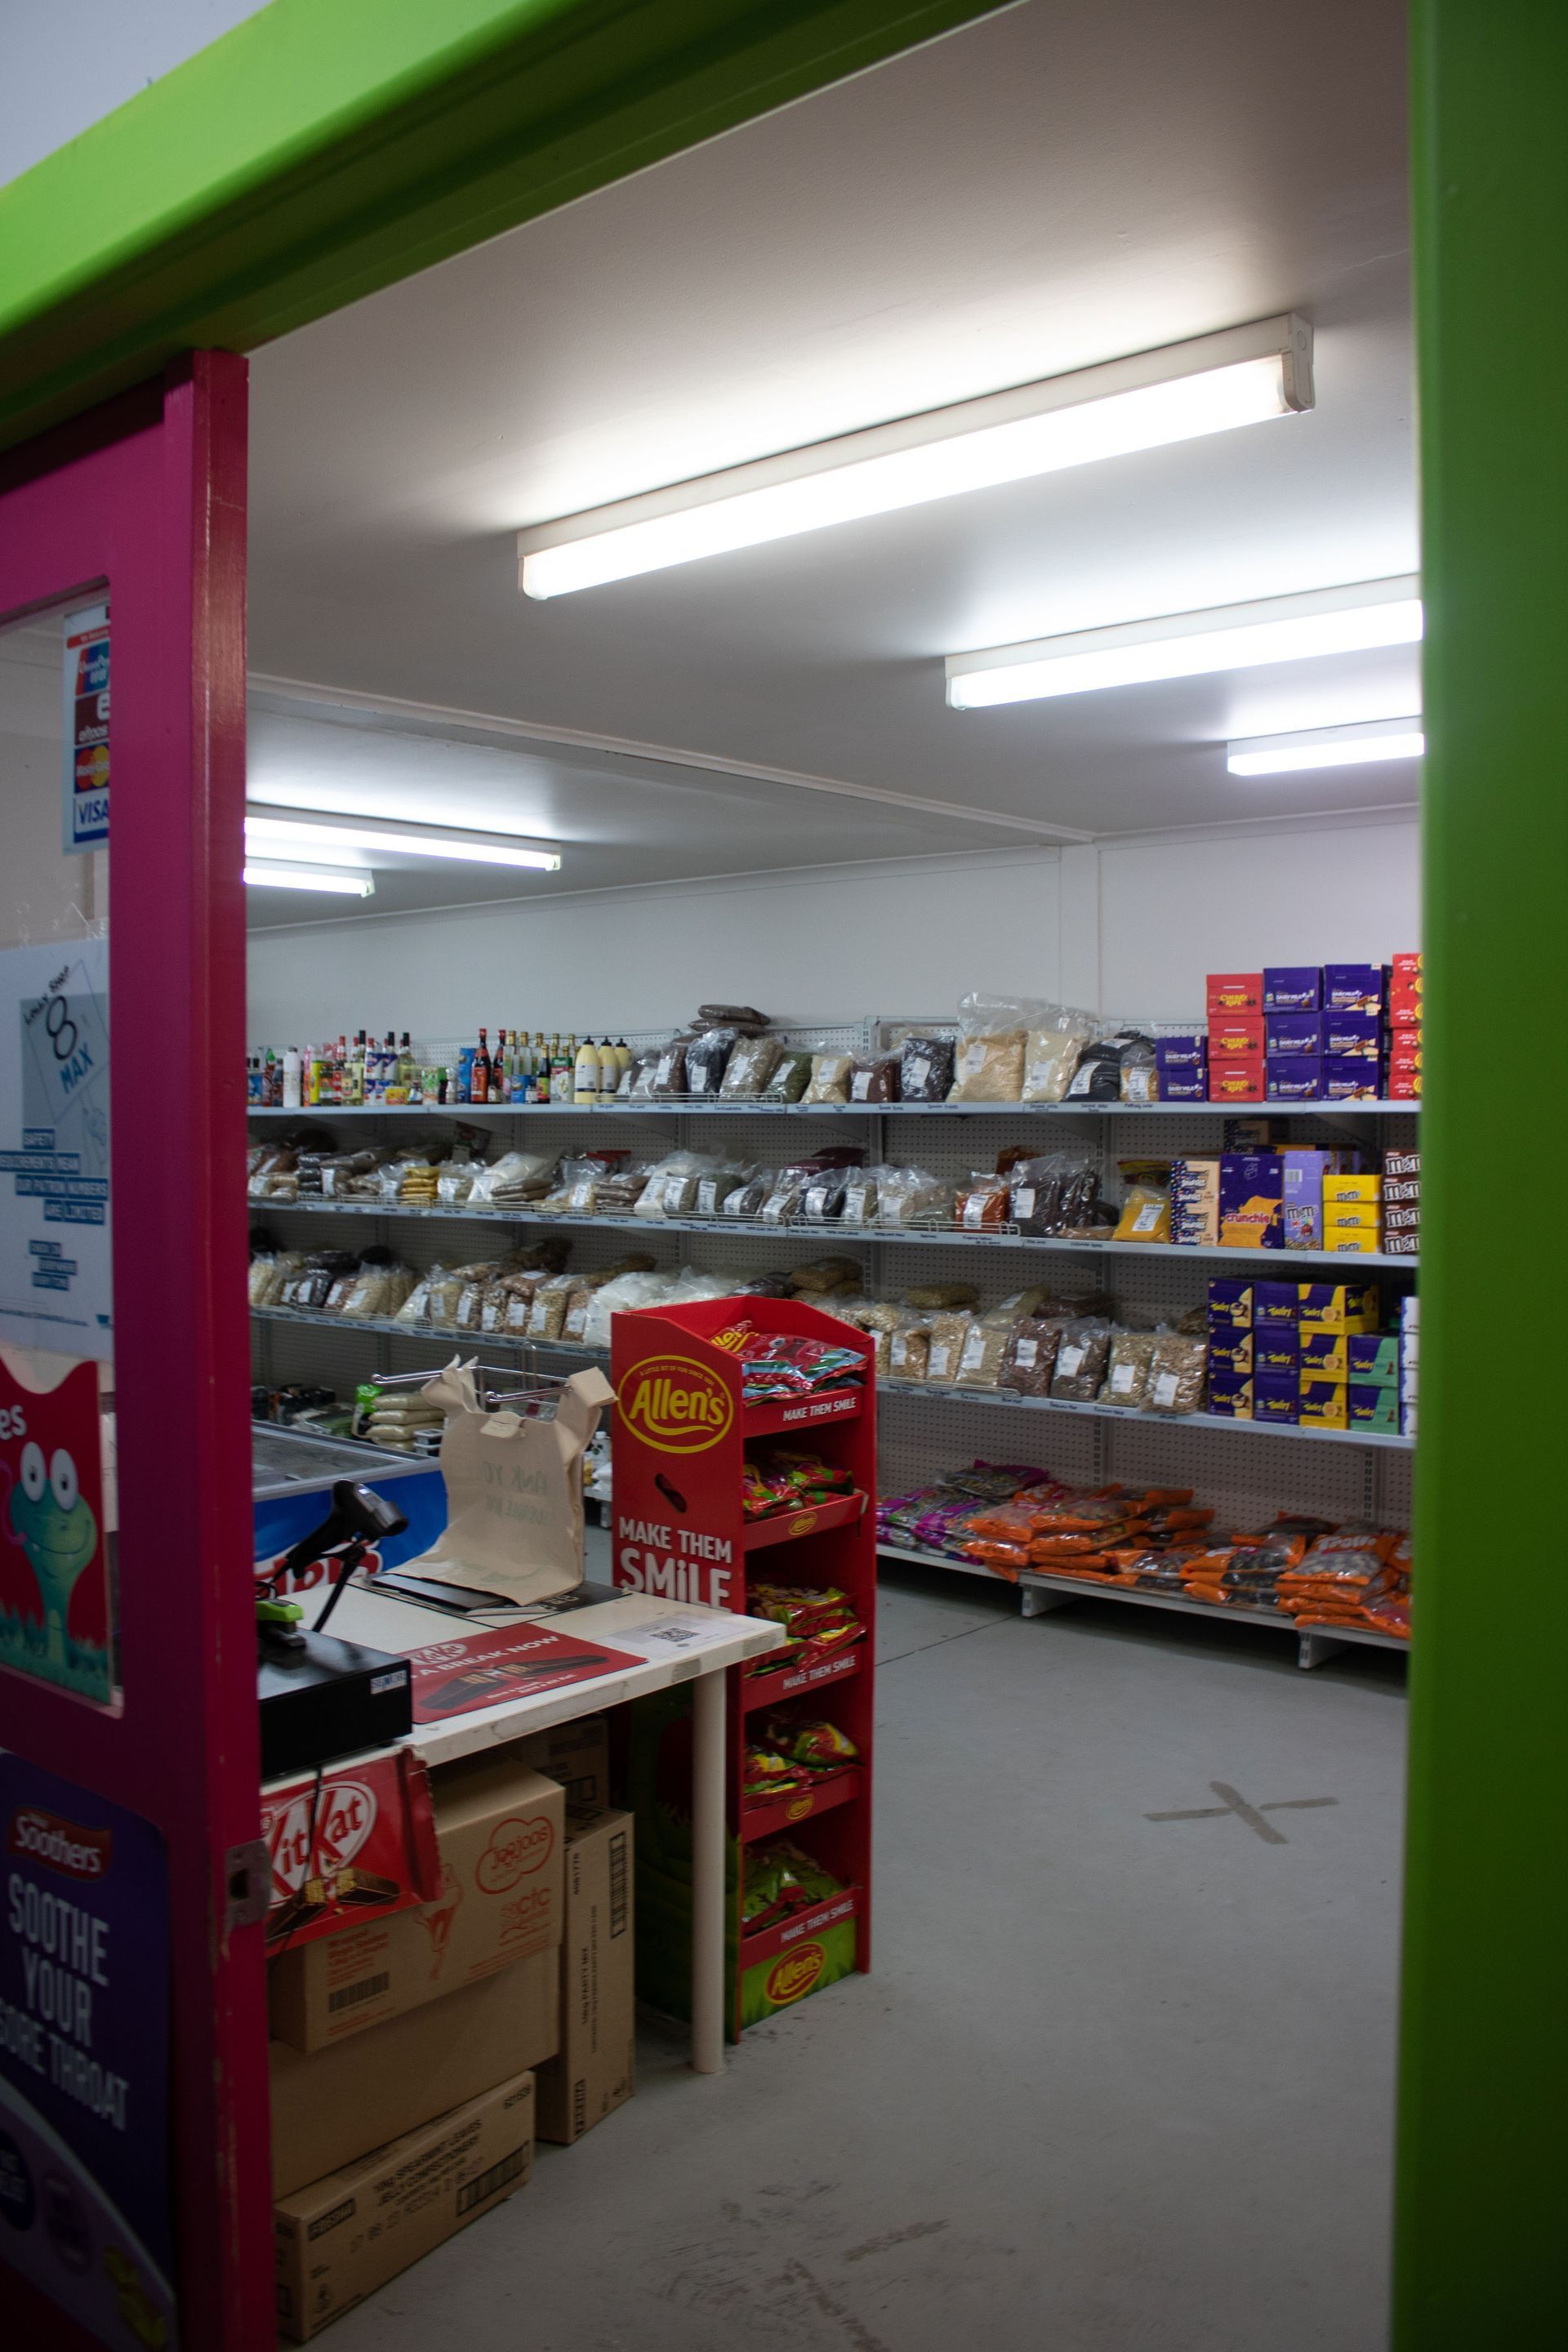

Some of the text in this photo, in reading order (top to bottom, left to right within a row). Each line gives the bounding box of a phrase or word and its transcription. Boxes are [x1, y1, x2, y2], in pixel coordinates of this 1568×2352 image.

[79, 800, 108, 824] VISA
[60, 1042, 94, 1094] MAX
[629, 1378, 726, 1435] Allen's
[782, 1396, 857, 1422] MAKE THEM SMILE
[618, 1516, 733, 1564] MAKE THEM
[438, 1650, 510, 1671] BREAK
[508, 1635, 561, 1653] NOW
[14, 1815, 103, 1873] Soothers
[8, 1873, 110, 1988] SOOTHE
[21, 1945, 93, 2048] YOUR
[48, 2031, 129, 2132] THROAT
